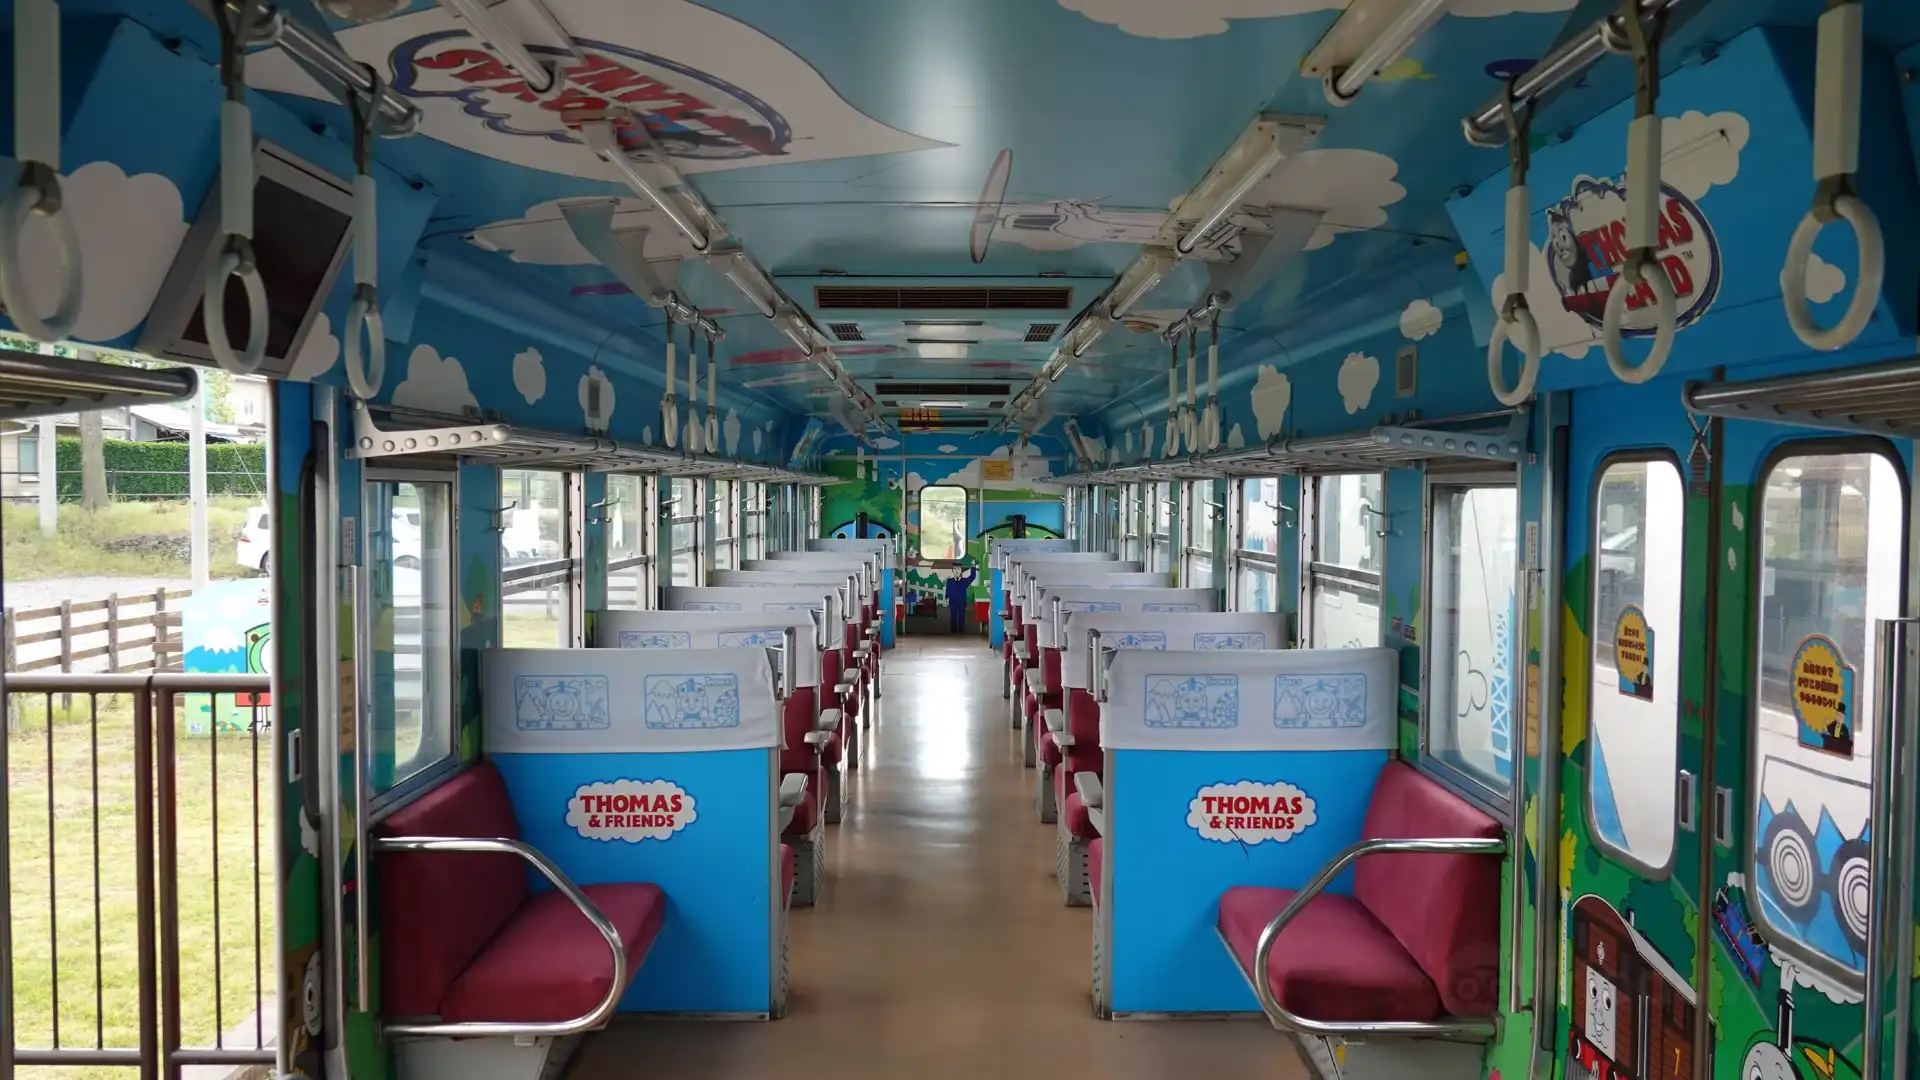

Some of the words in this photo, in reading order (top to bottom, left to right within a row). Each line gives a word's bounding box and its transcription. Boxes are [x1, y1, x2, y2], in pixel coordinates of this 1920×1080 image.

[1578, 197, 1693, 270] THOAS
[580, 795, 682, 813] THOMAS
[1201, 796, 1303, 815] THOMAS
[588, 815, 601, 828] &
[605, 815, 675, 828] FRIENDS
[1209, 816, 1221, 829] &
[1225, 817, 1295, 829] FRIENDS
